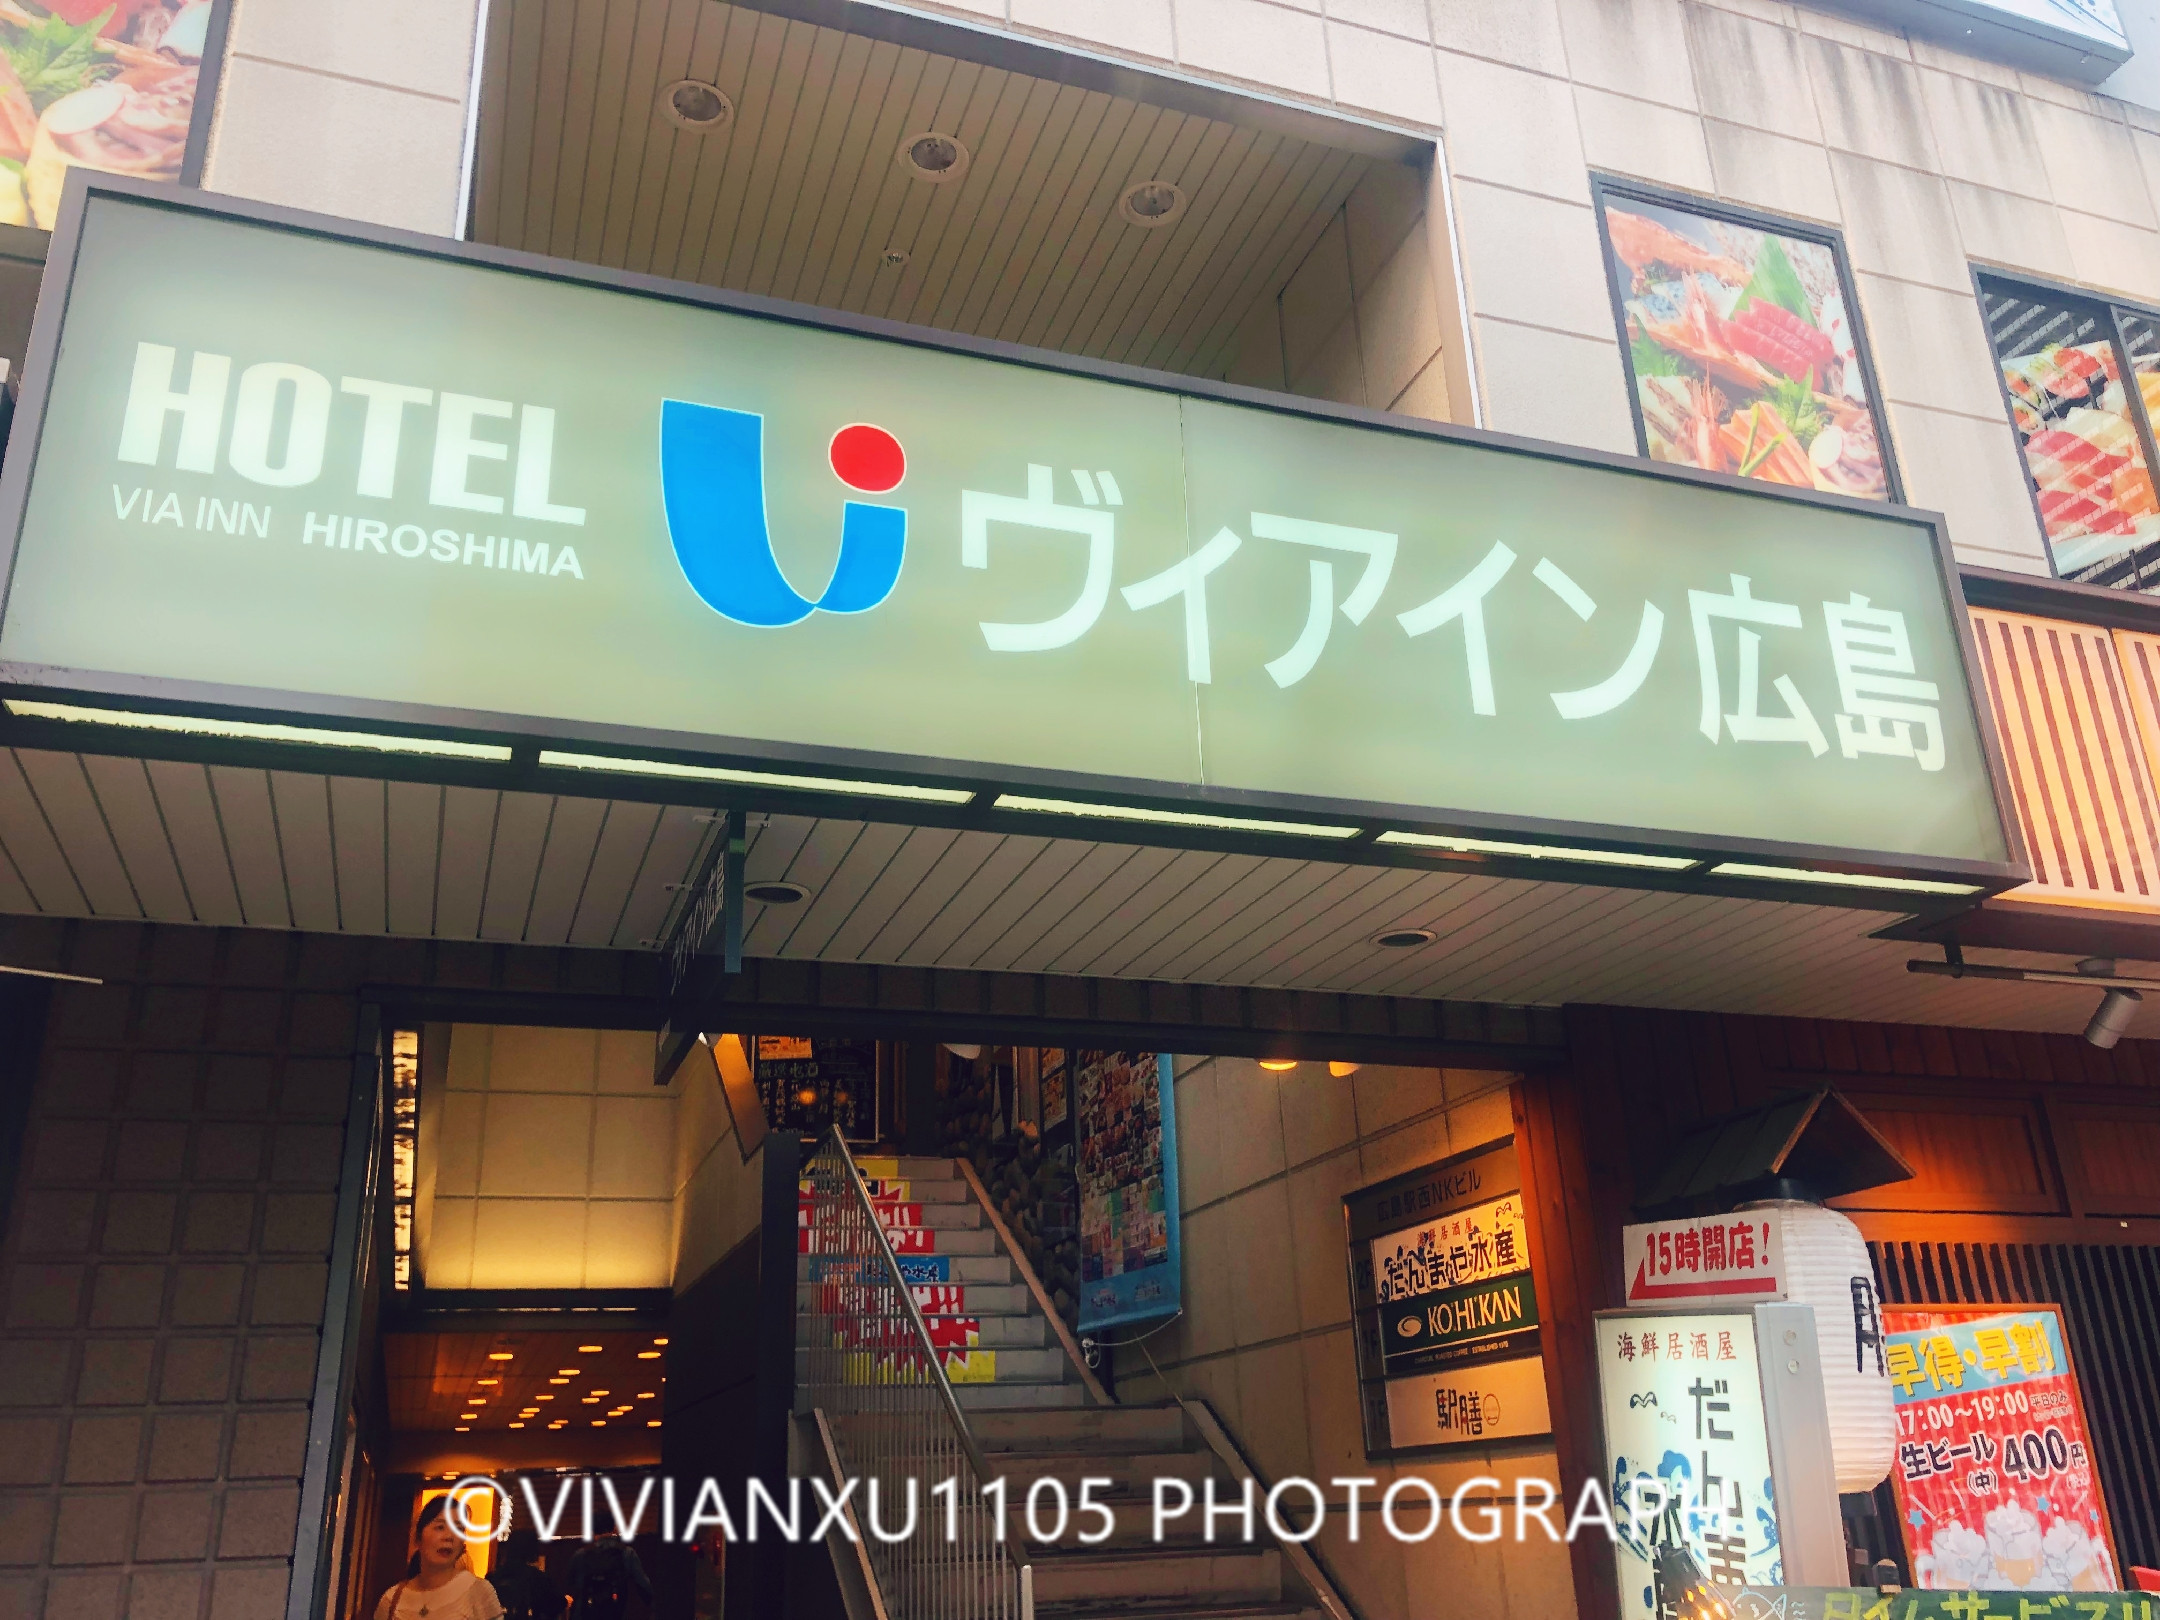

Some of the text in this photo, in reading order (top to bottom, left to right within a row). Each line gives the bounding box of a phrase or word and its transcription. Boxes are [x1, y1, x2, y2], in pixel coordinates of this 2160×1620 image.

[117, 341, 587, 527] HOTEL
[112, 484, 585, 580] VIA INN HIROSHIMA
[961, 463, 1947, 772] ヴィアイン広島
[1387, 1229, 1517, 1296] だんまや水産
[1646, 1221, 1771, 1277] 15時開店!
[1428, 1286, 1522, 1337] KOHIKAN
[1616, 1331, 1738, 1363] 海鮮居酒屋
[1886, 1320, 2057, 1397] 早得・早割
[1899, 1431, 1998, 1481] 生ビール
